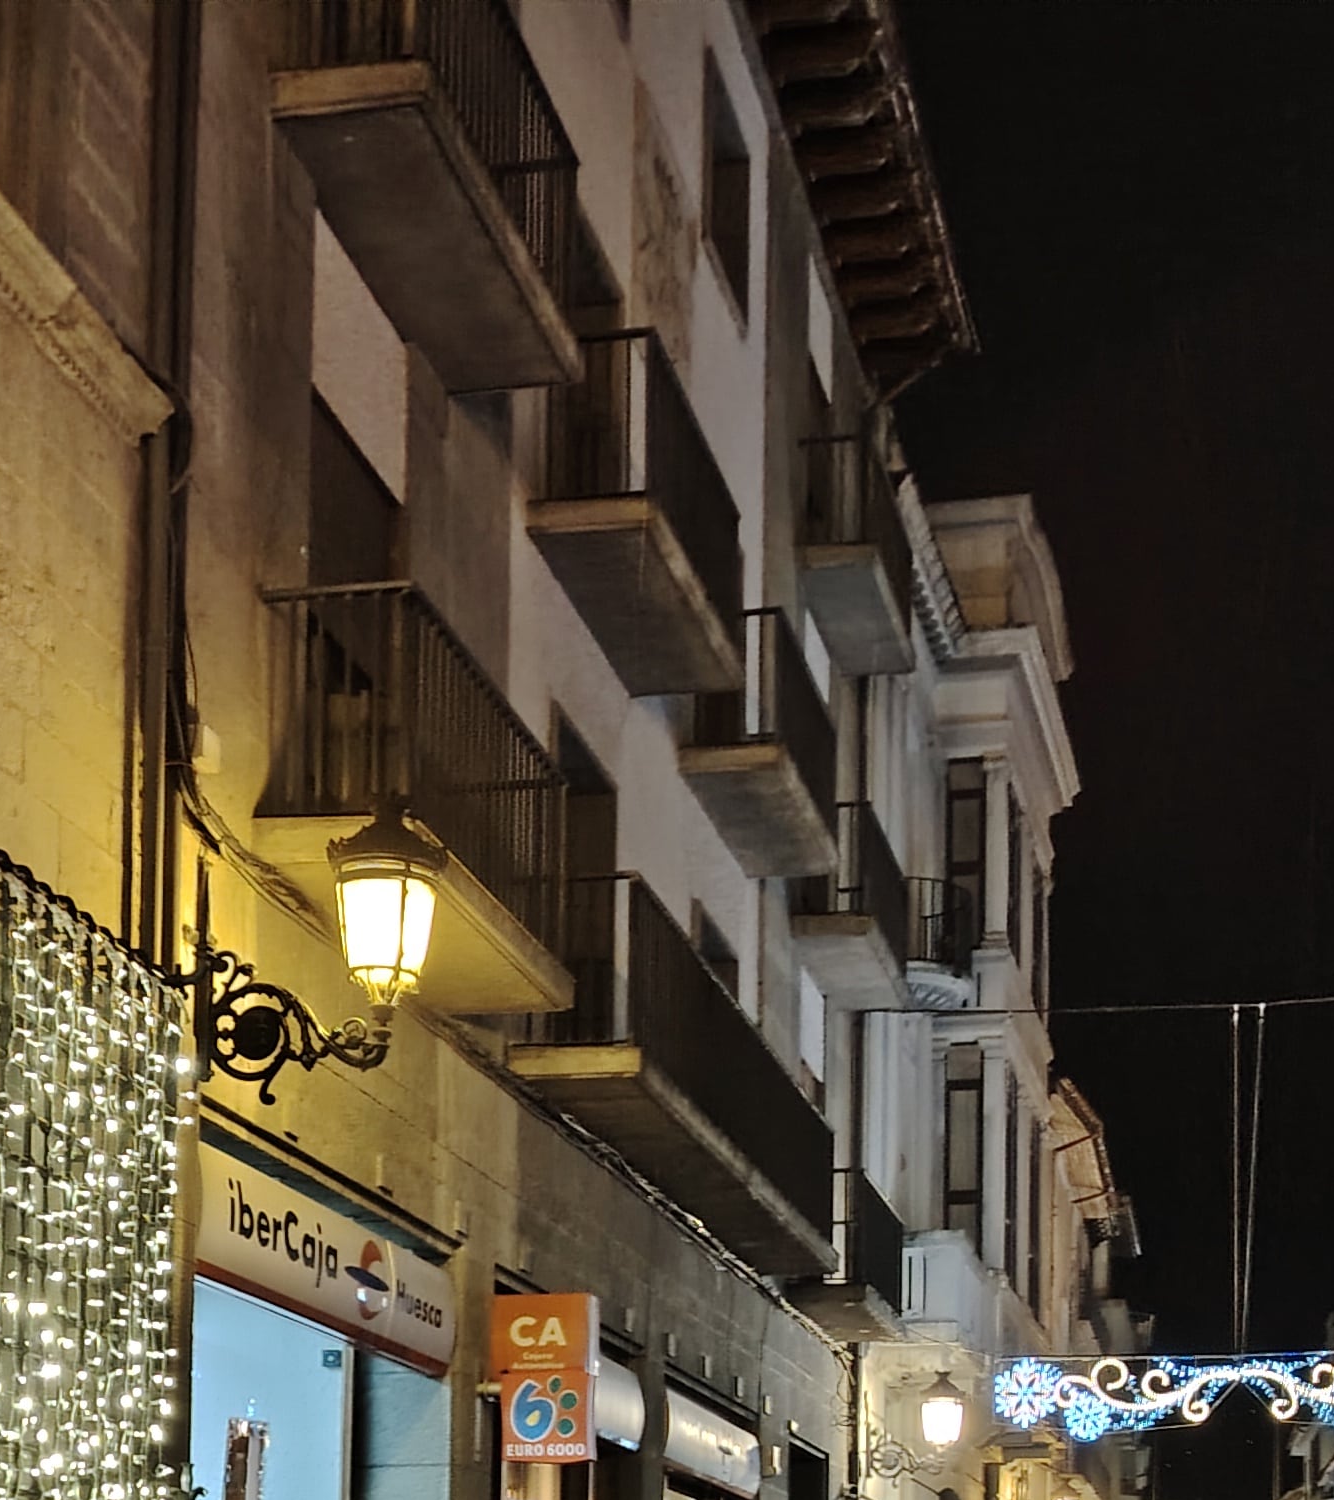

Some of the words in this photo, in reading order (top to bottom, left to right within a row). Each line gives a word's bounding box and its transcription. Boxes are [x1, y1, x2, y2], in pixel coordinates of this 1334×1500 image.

[228, 1177, 338, 1288] iberCaja
[396, 1279, 443, 1329] Huesca
[509, 1315, 567, 1347] CA
[506, 1444, 543, 1457] EURO
[546, 1443, 586, 1456] 6000
